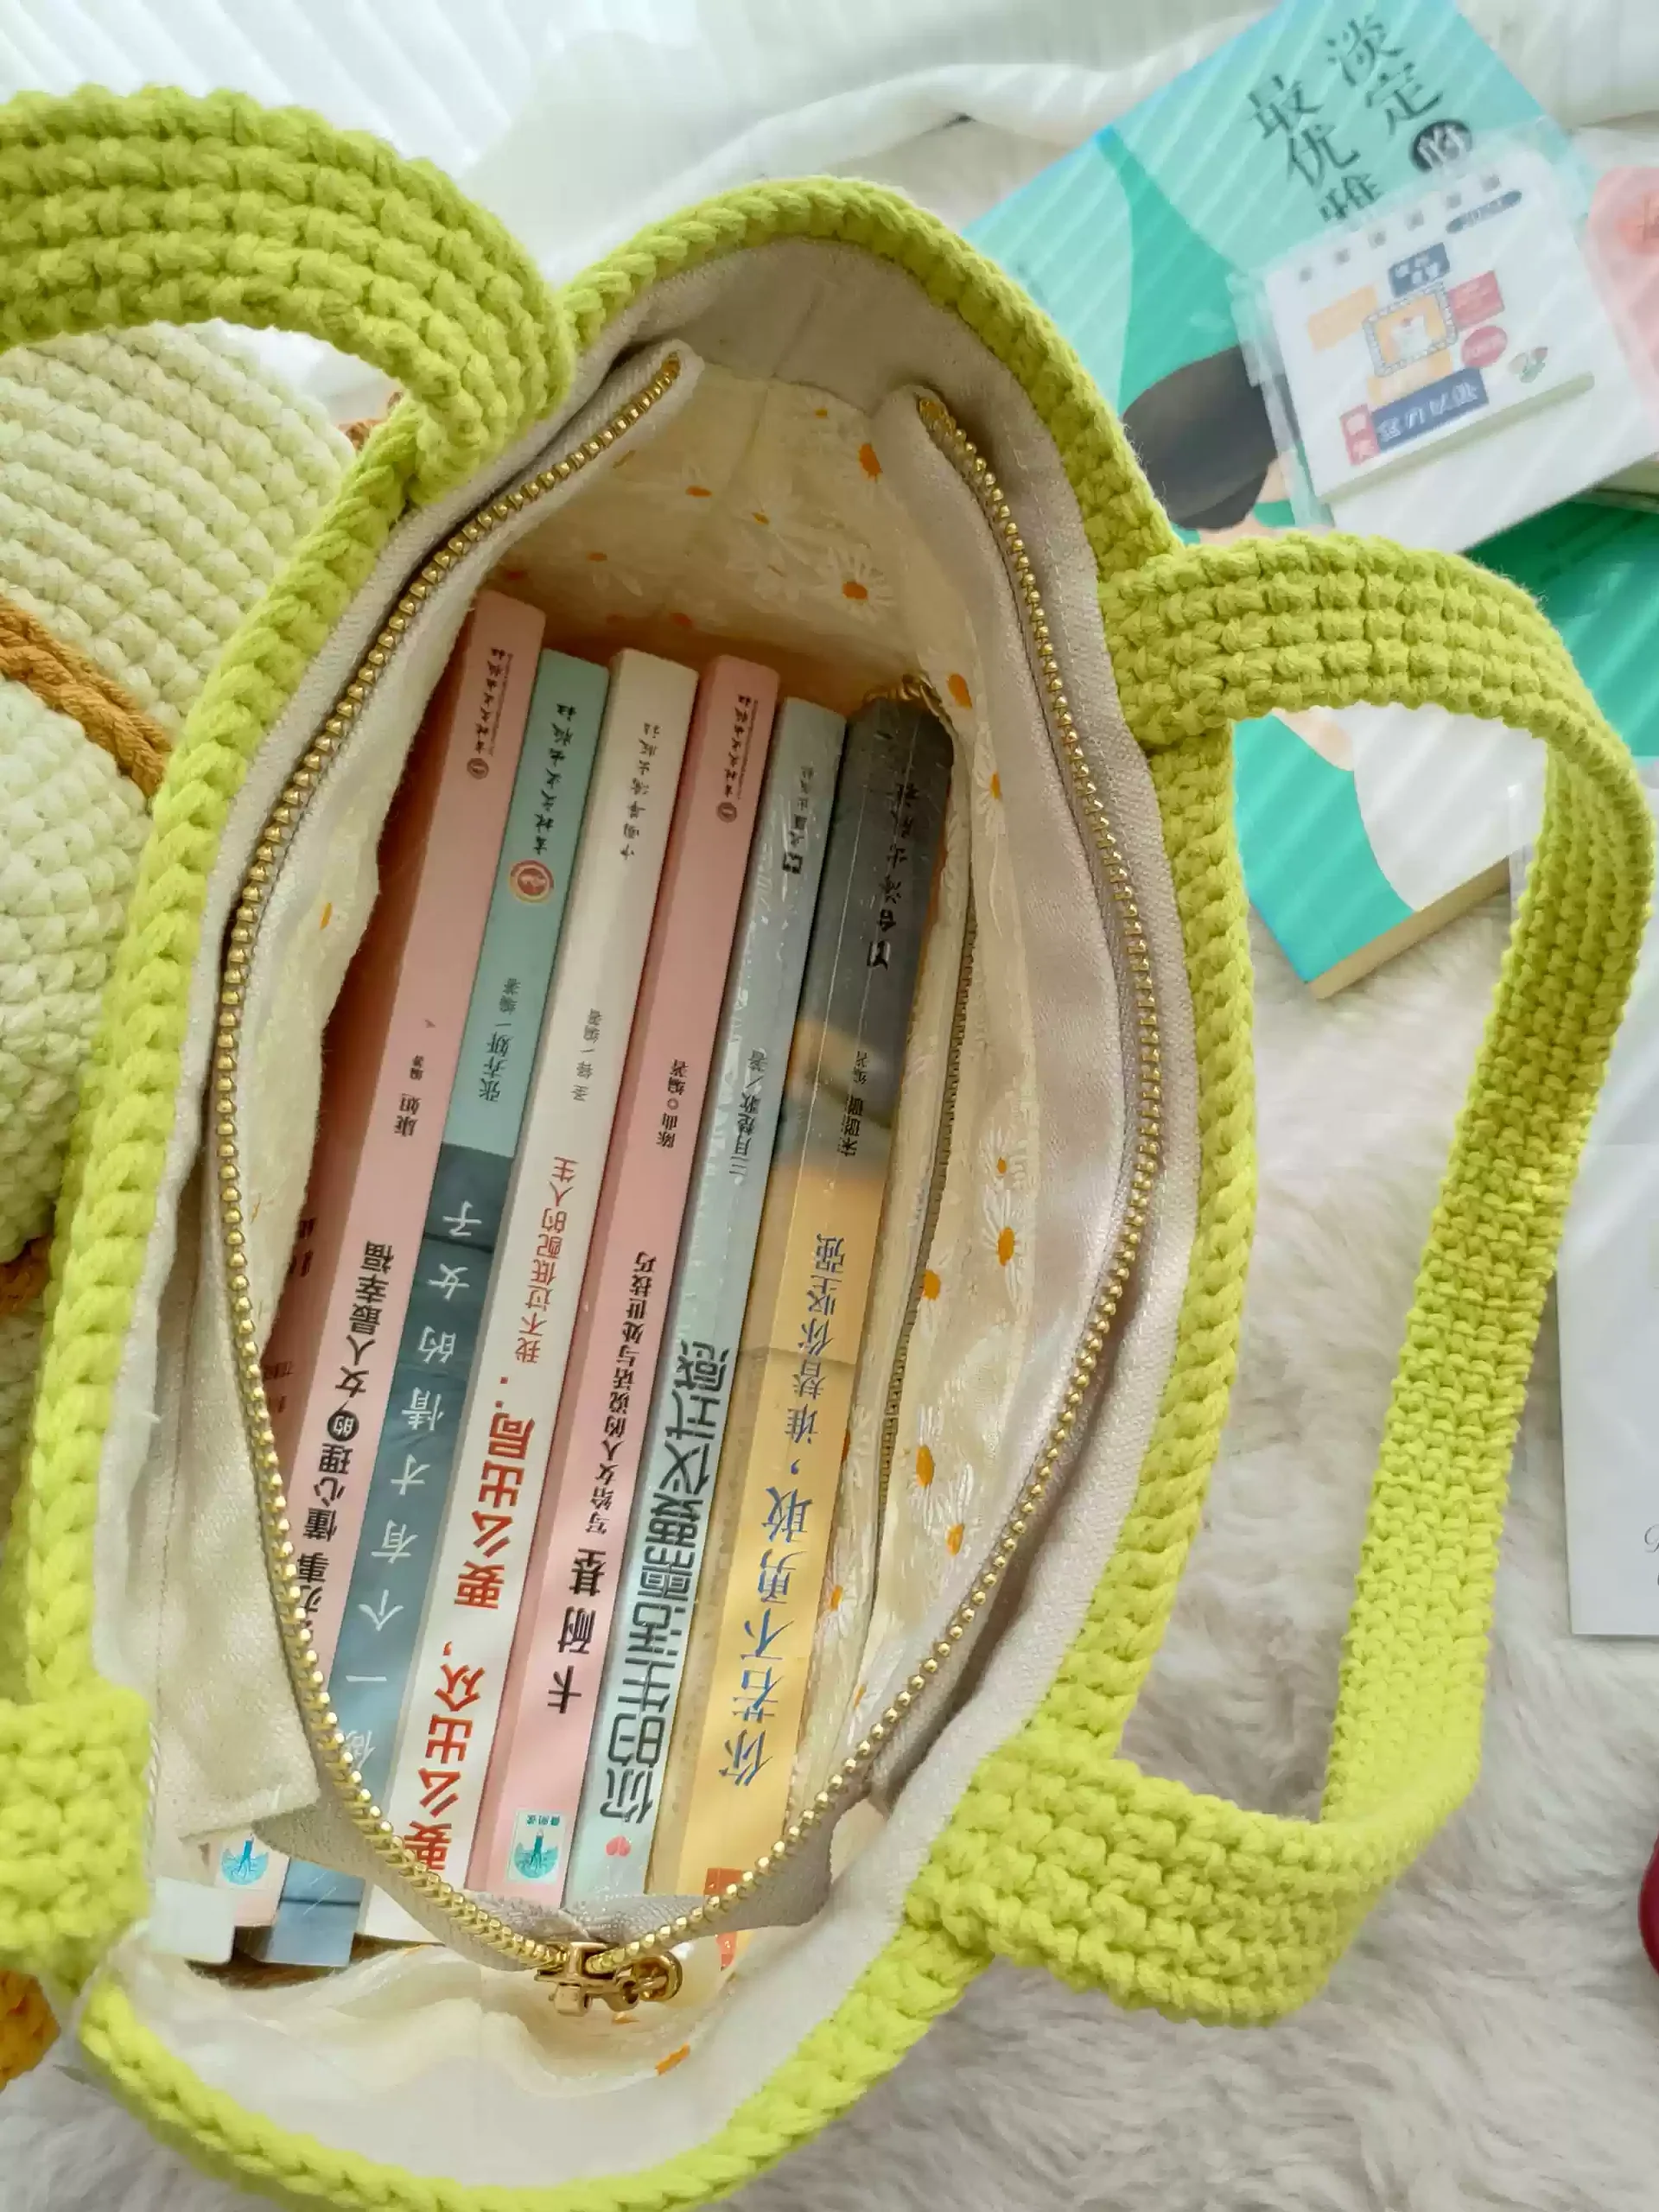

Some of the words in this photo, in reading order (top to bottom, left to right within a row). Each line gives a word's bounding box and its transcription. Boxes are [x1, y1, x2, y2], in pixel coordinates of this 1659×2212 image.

[1326, 16, 1472, 173] 淡定的
[532, 702, 578, 857] 吉林文史出版社
[514, 1154, 579, 1364] 我不过低配的人生
[546, 1547, 608, 1714] 卡耐基
[586, 1249, 659, 1535] 写给女人的说话与处世技巧
[598, 1338, 731, 1825] 你的生活需要仪式感
